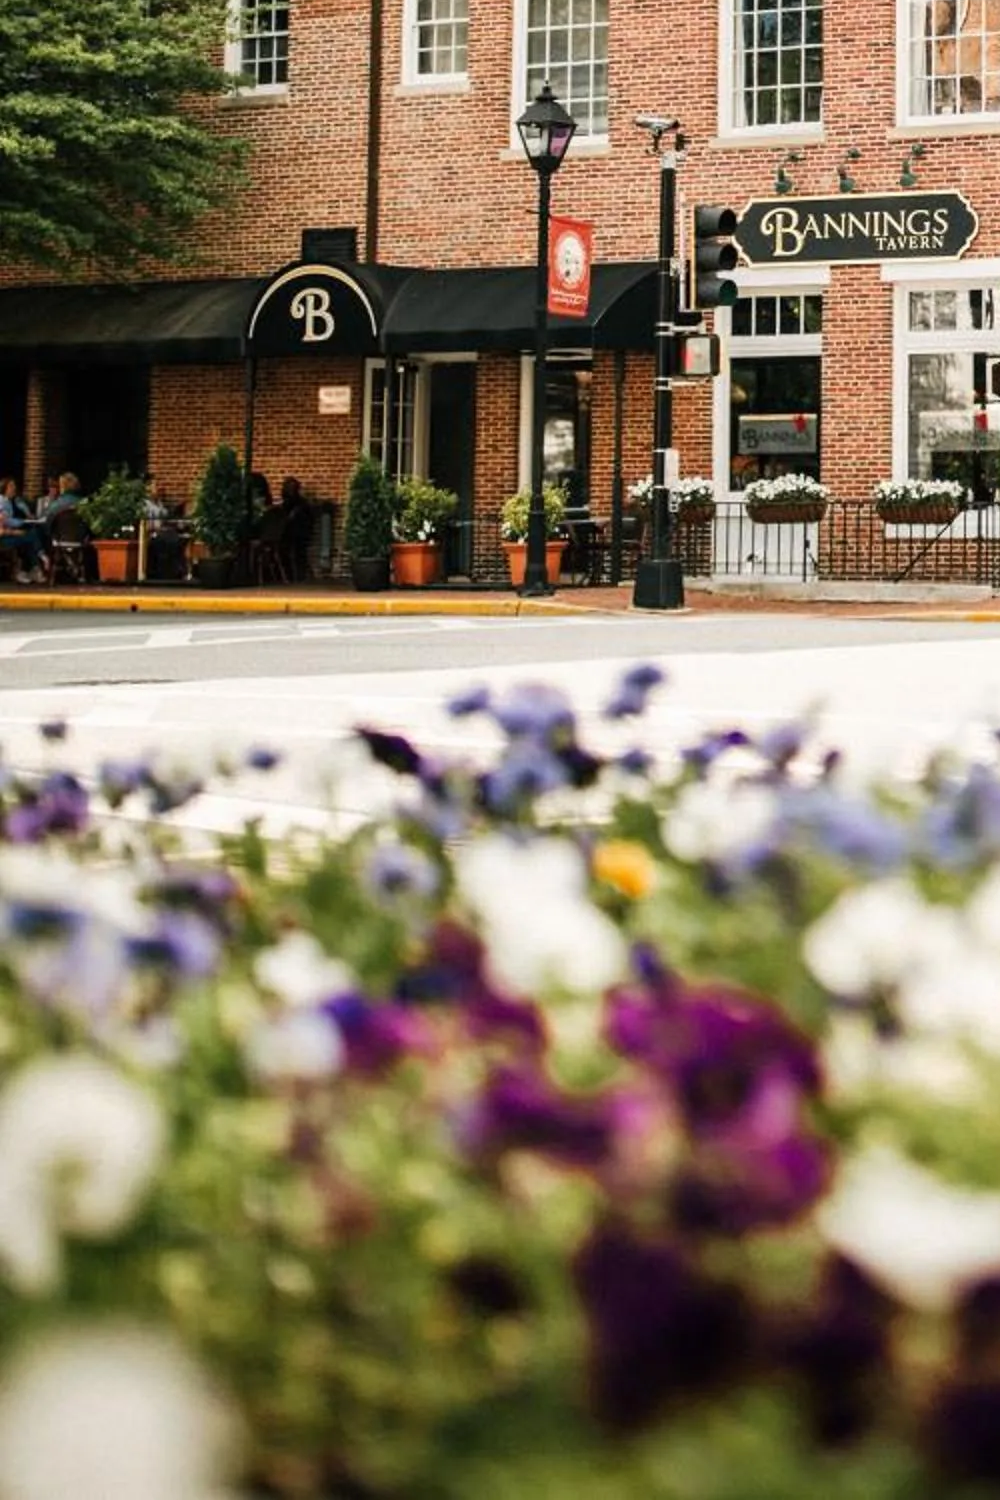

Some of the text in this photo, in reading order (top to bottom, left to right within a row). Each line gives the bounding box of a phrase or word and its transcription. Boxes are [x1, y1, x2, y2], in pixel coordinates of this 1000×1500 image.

[760, 207, 949, 257] BANNINGS
[875, 236, 945, 251] TAVERN
[290, 287, 335, 342] B
